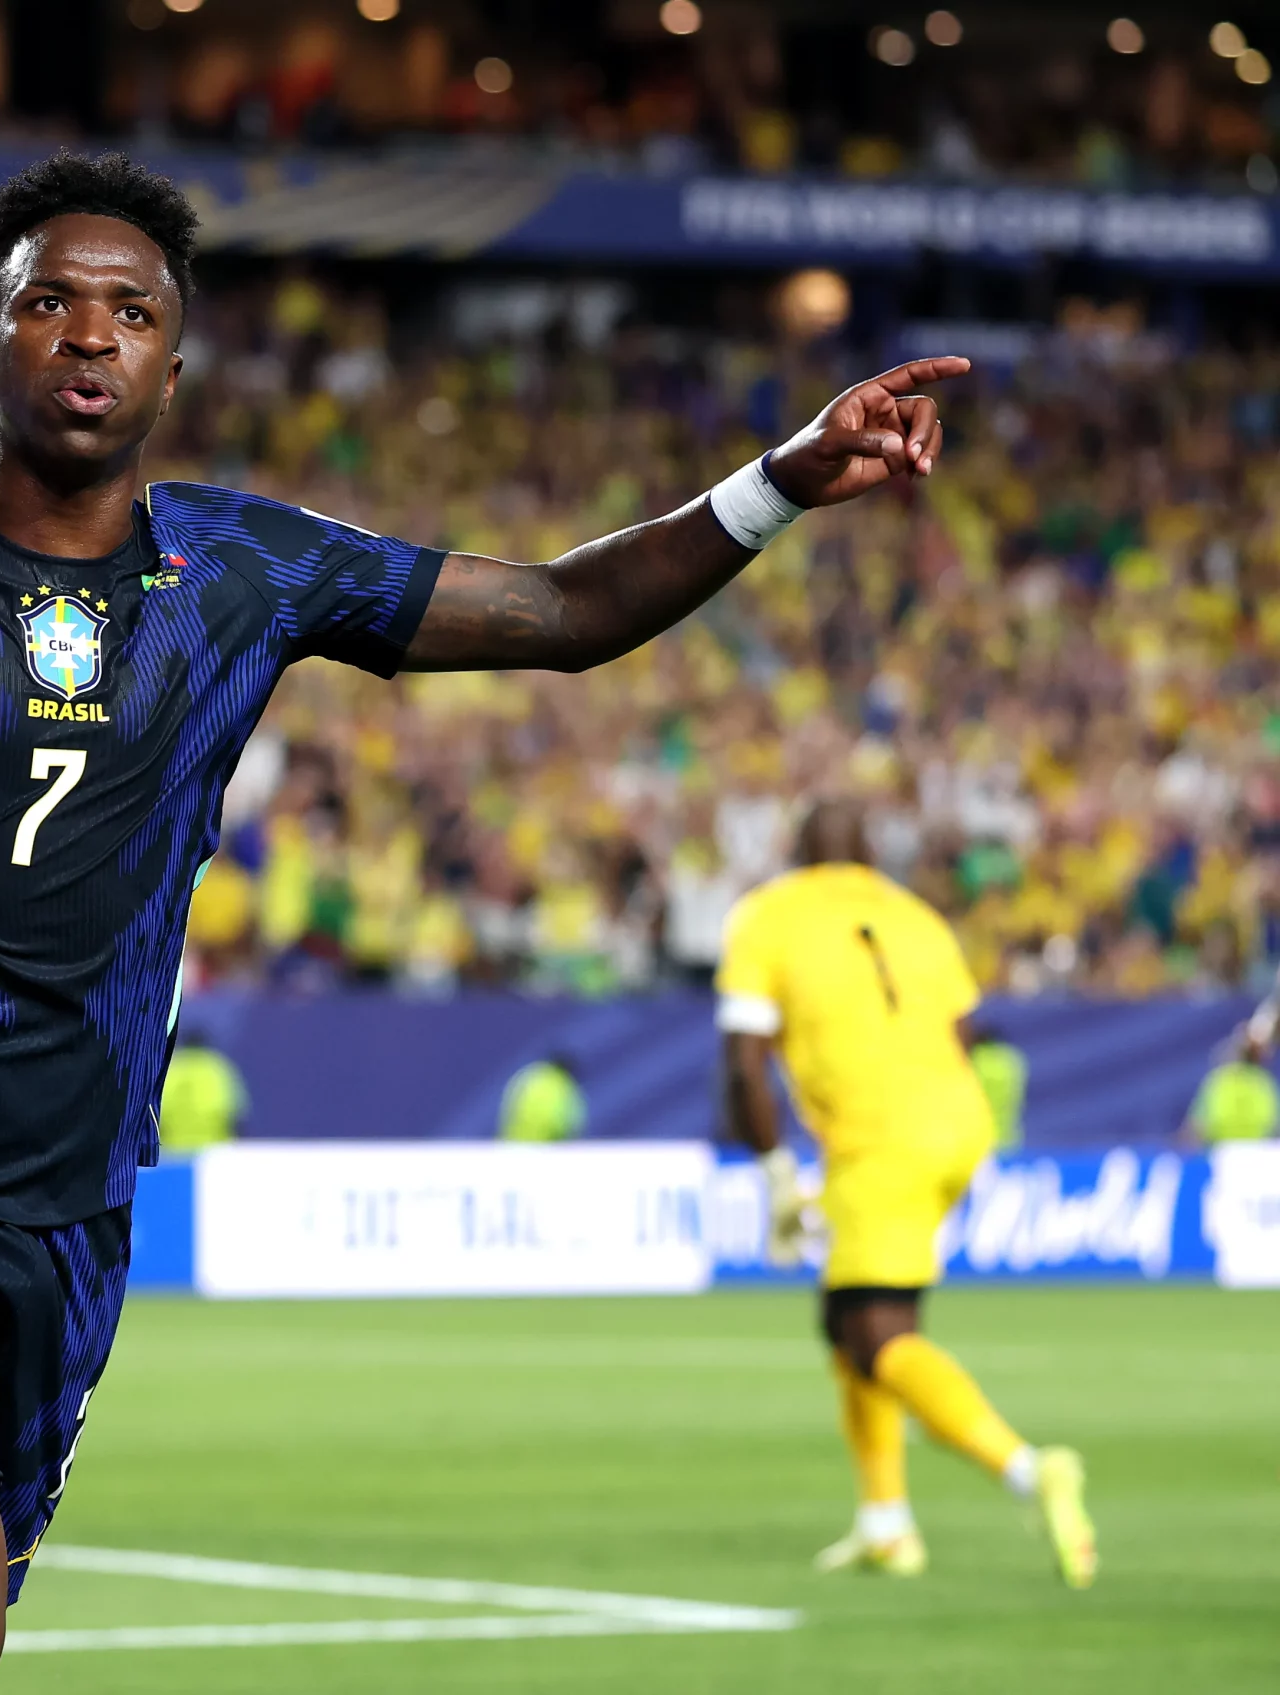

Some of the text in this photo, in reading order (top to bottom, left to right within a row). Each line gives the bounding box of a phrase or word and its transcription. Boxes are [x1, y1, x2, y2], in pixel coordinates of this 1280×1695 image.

[683, 181, 792, 243] FIFA
[806, 185, 977, 248] WORLD
[27, 698, 110, 723] BRASIL
[11, 747, 88, 867] 7
[855, 922, 900, 1015] 1
